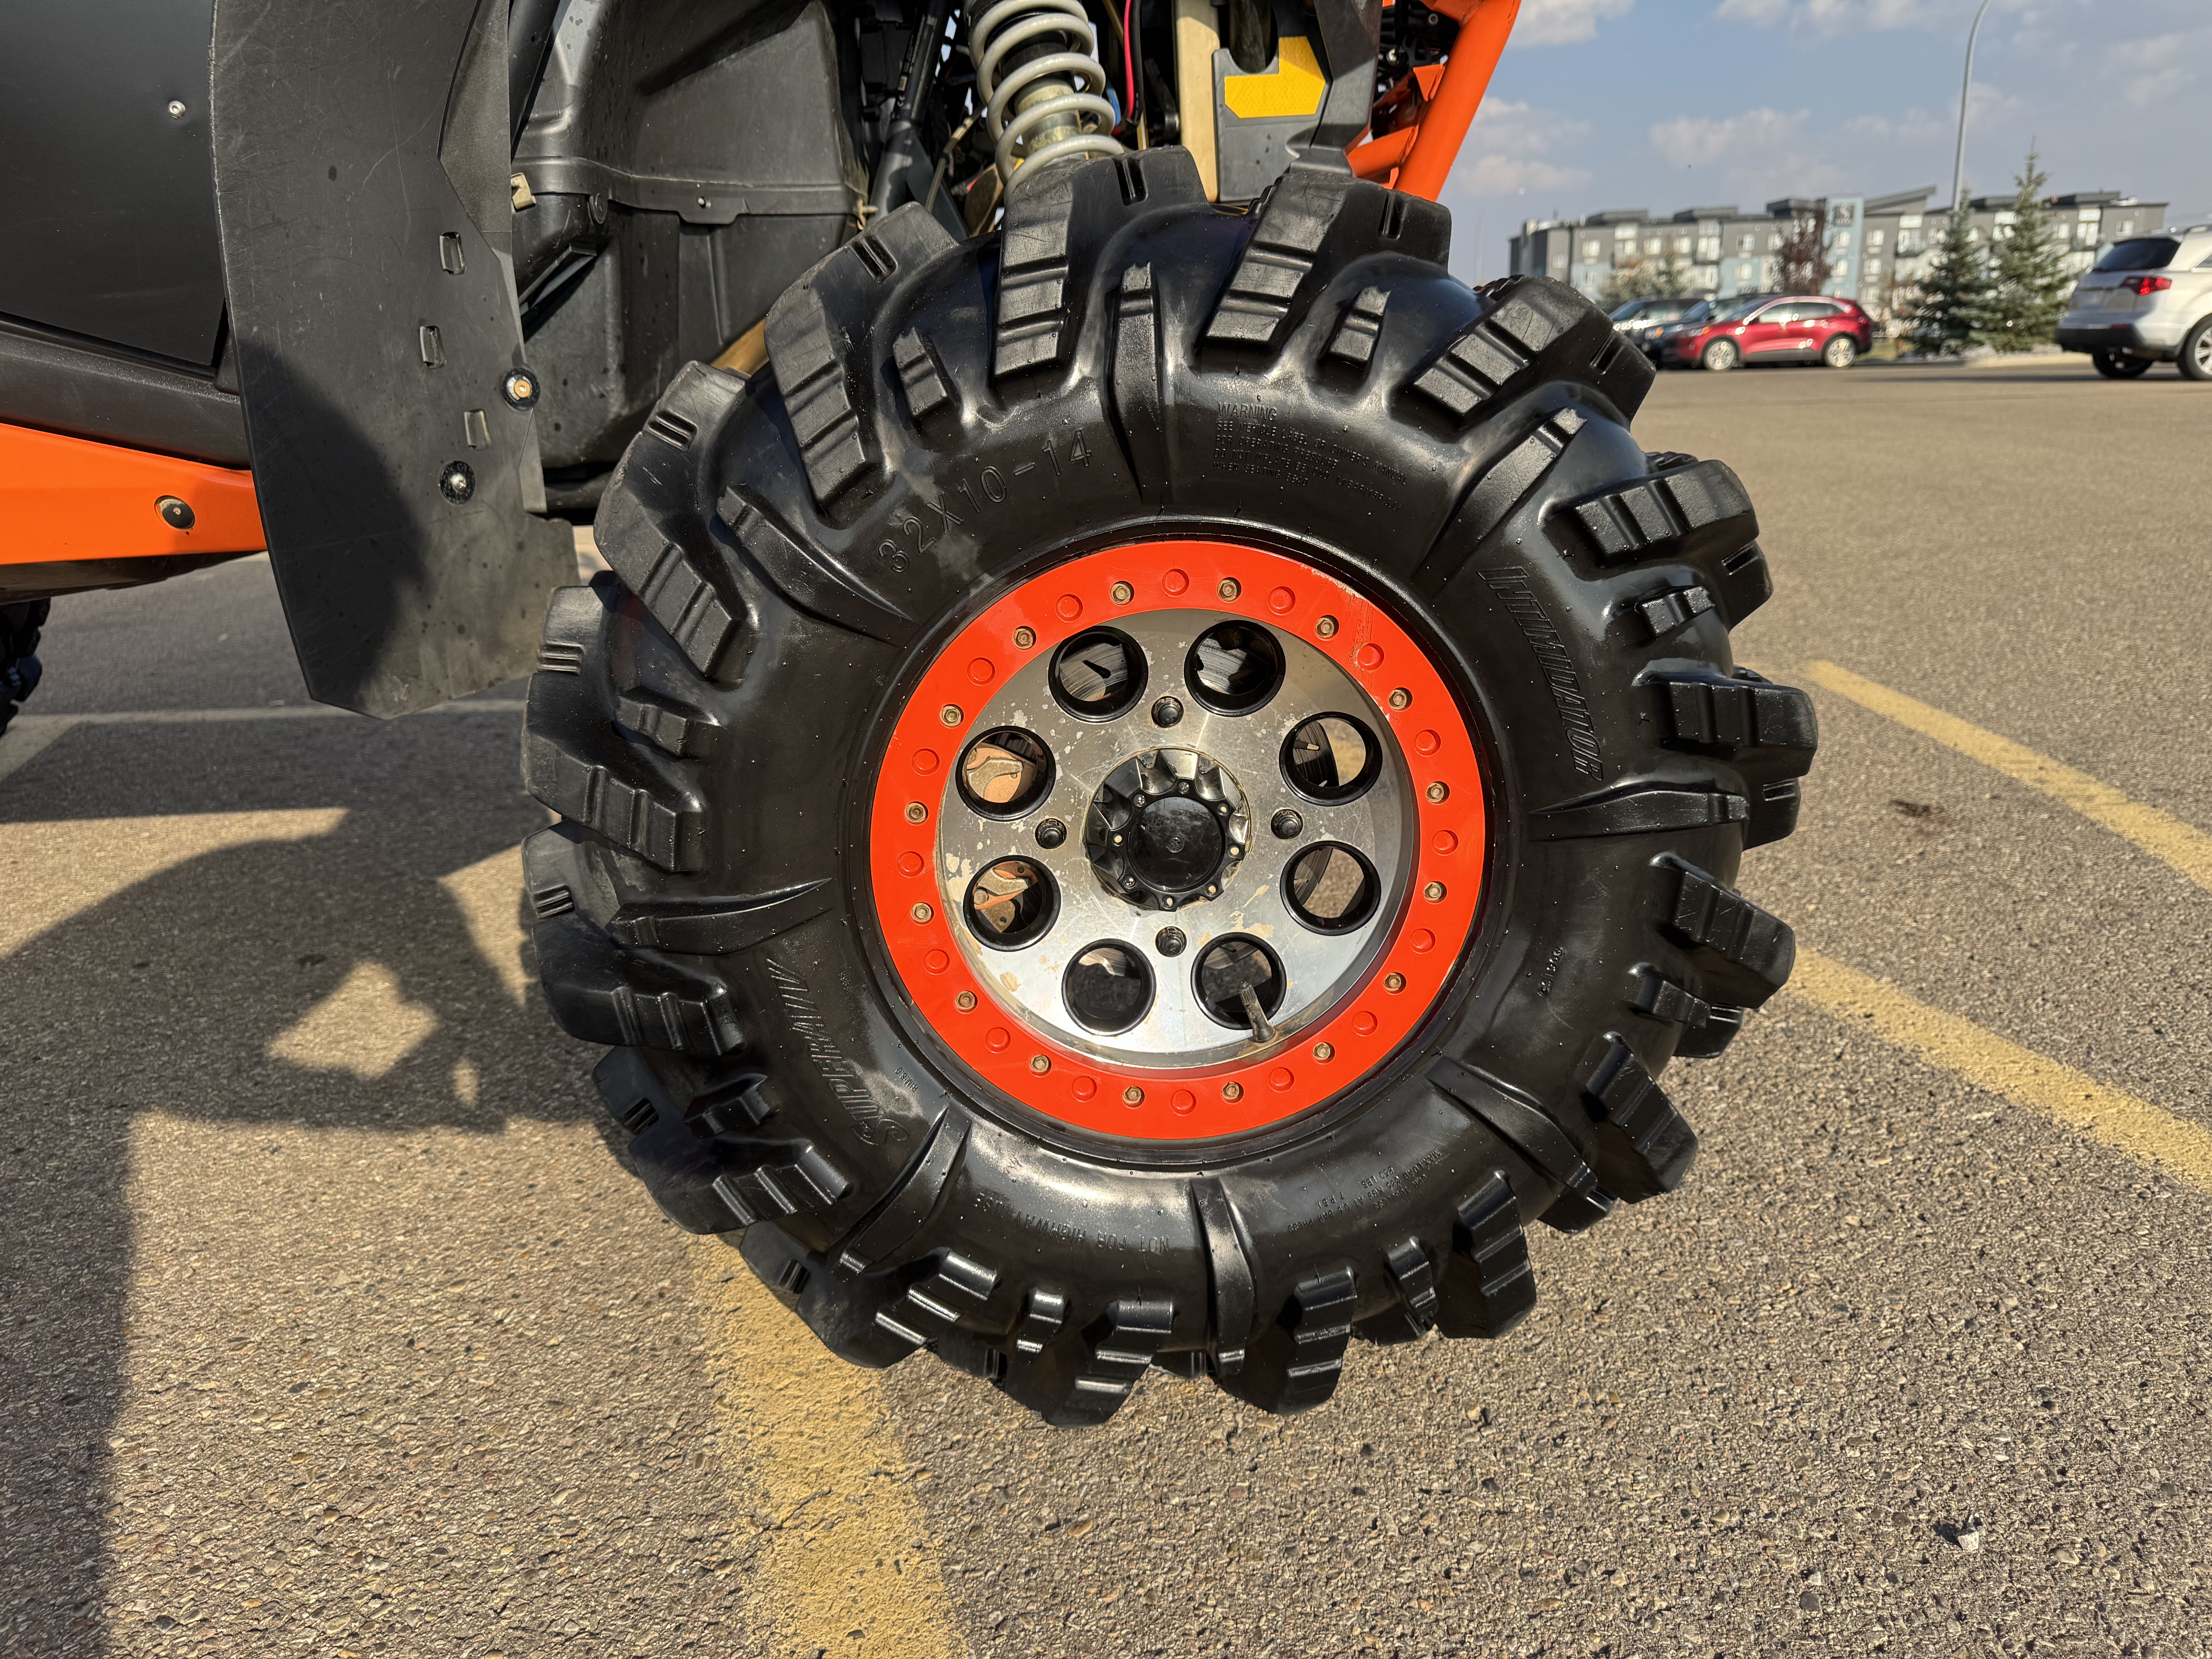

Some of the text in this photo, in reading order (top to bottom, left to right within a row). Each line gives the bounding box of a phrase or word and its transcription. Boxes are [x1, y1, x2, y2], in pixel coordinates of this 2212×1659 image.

[1218, 402, 1277, 421] WARNING
[1214, 448, 1226, 457] DO
[1232, 450, 1250, 459] NOT
[1255, 453, 1291, 467] INFLATE
[1296, 462, 1329, 479] BEYOND
[1216, 435, 1338, 469] FOR OPERATING PRESSURE
[1217, 421, 1407, 485] SEE VEHICLE LABEL OR OWNER'S MANUAL
[1213, 462, 1309, 486] WHEN SEATING BEAD
[1476, 566, 1604, 781] INTIMIDATOR
[1340, 1192, 1345, 1200] 7
[1362, 1175, 1377, 1188] LBS
[972, 1192, 1170, 1253] NOT FOR HIGHWAY USE
